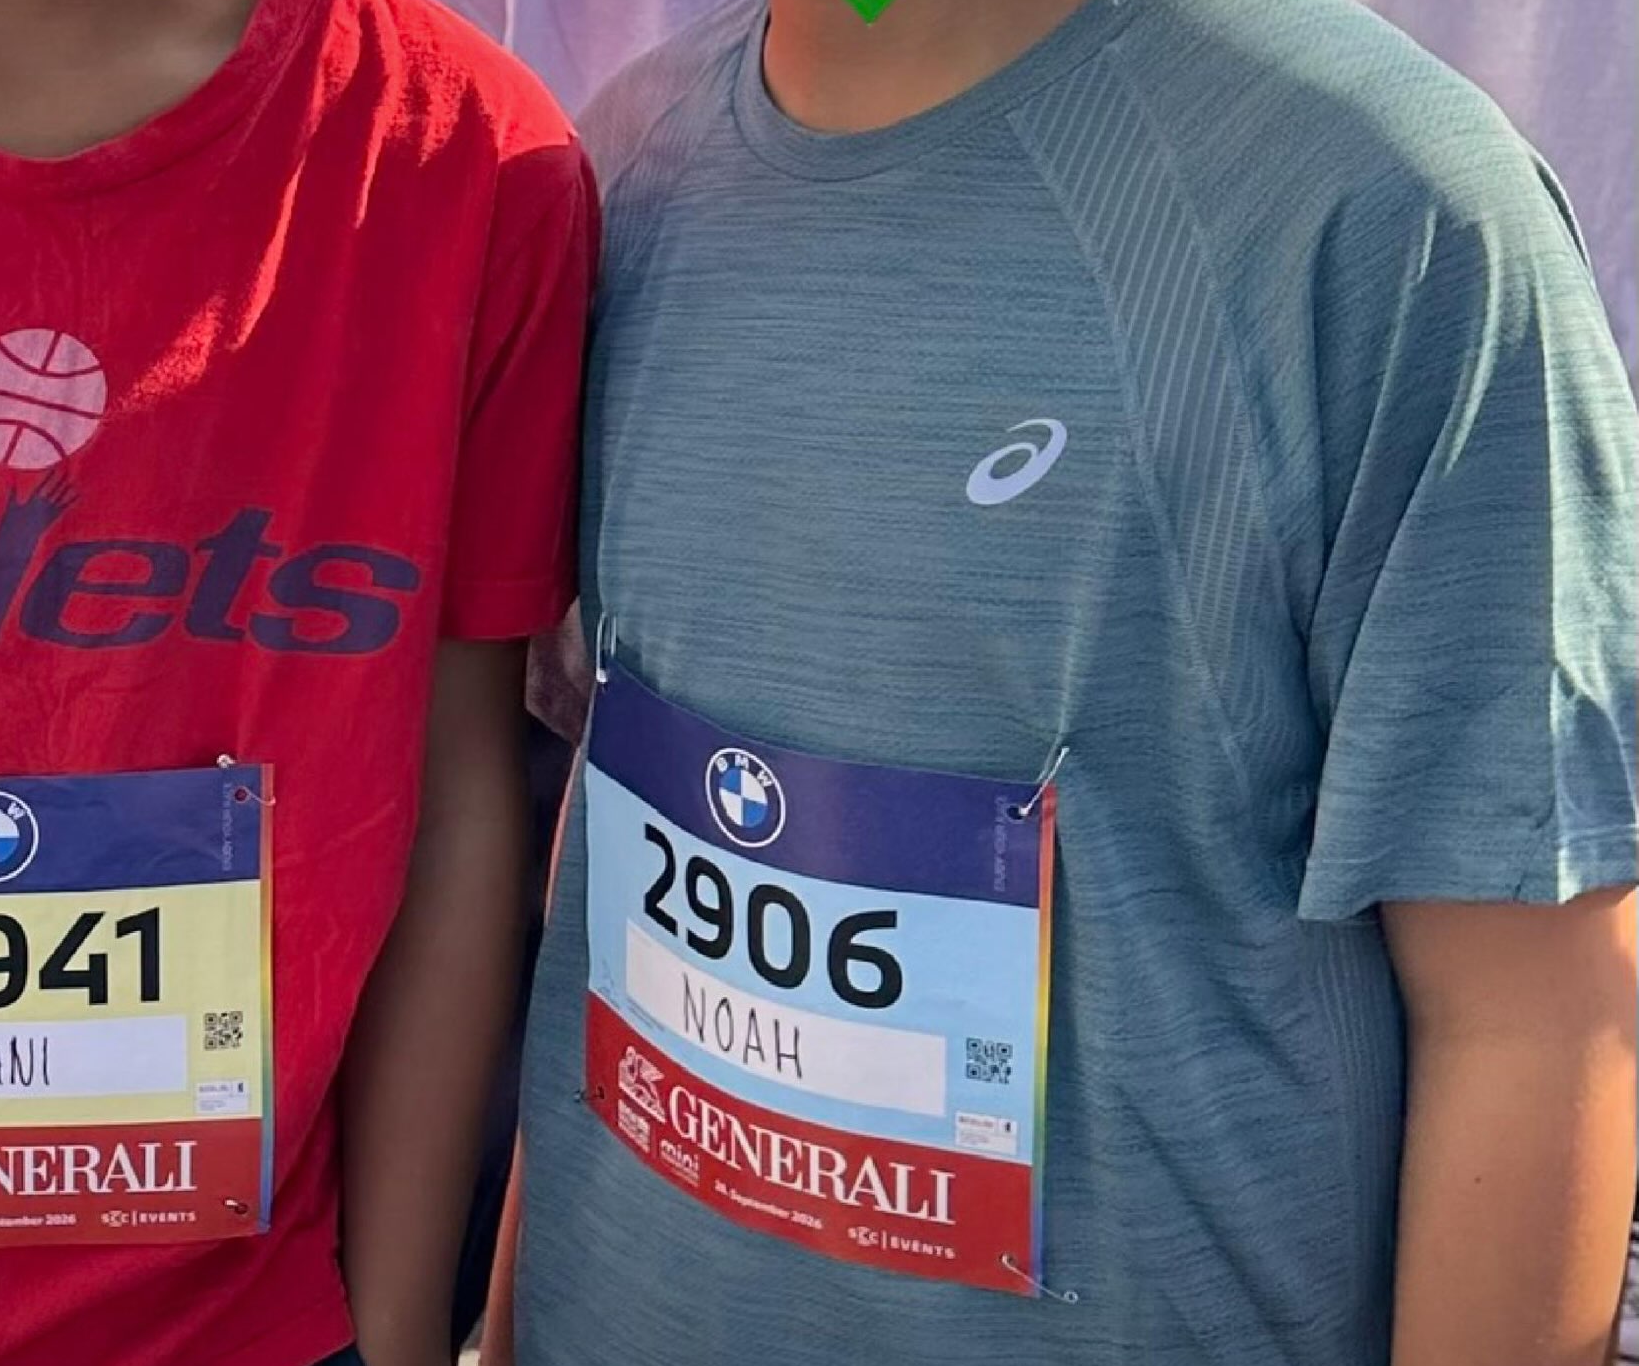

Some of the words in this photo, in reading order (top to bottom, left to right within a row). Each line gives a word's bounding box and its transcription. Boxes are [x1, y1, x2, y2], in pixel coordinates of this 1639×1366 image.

[643, 823, 904, 1010] 2906
[682, 972, 803, 1080] NOAH
[660, 1139, 699, 1172] mini
[667, 1086, 957, 1227] GENERALI
[139, 1210, 197, 1223] EVENTS
[890, 1236, 956, 1260] EVENTS
